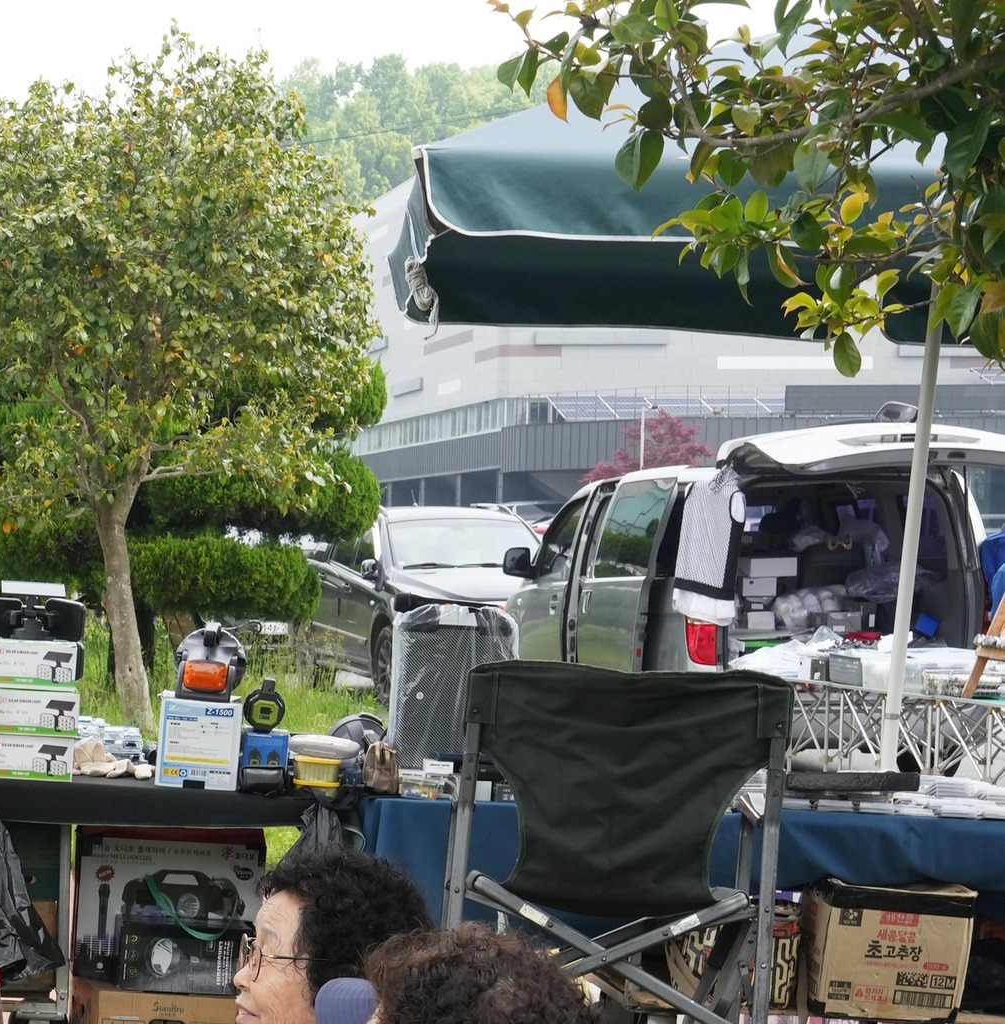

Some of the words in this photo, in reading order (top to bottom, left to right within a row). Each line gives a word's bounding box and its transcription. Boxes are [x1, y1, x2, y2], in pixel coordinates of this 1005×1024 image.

[206, 708, 234, 716] Z-1500
[114, 845, 135, 853] 오디오
[137, 845, 166, 855] 플레이어
[98, 869, 112, 878] NEW
[877, 929, 917, 944] 새콤달콤
[864, 939, 923, 962] 초고추장
[865, 986, 884, 995] 던지지
[153, 1002, 185, 1013] Sumifru
